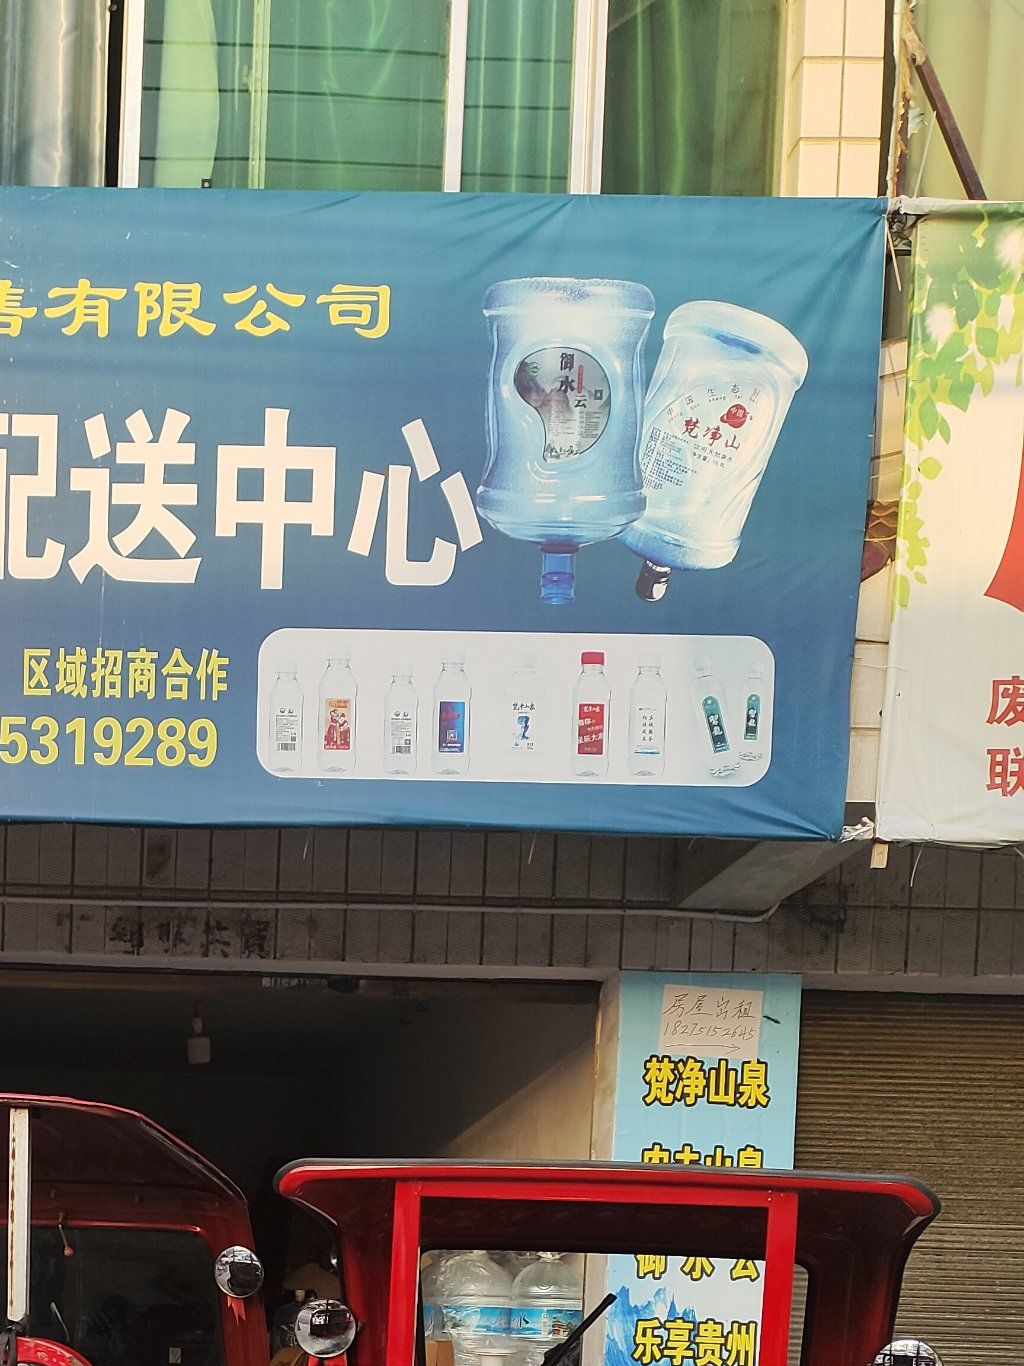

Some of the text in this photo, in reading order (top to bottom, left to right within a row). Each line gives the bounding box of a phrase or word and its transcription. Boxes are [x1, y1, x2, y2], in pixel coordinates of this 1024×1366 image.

[22, 646, 230, 701] 区域招商合作
[663, 993, 756, 1019] 房屋出租
[663, 1020, 758, 1041] 18275152645
[642, 1054, 772, 1109] 梵净山泉
